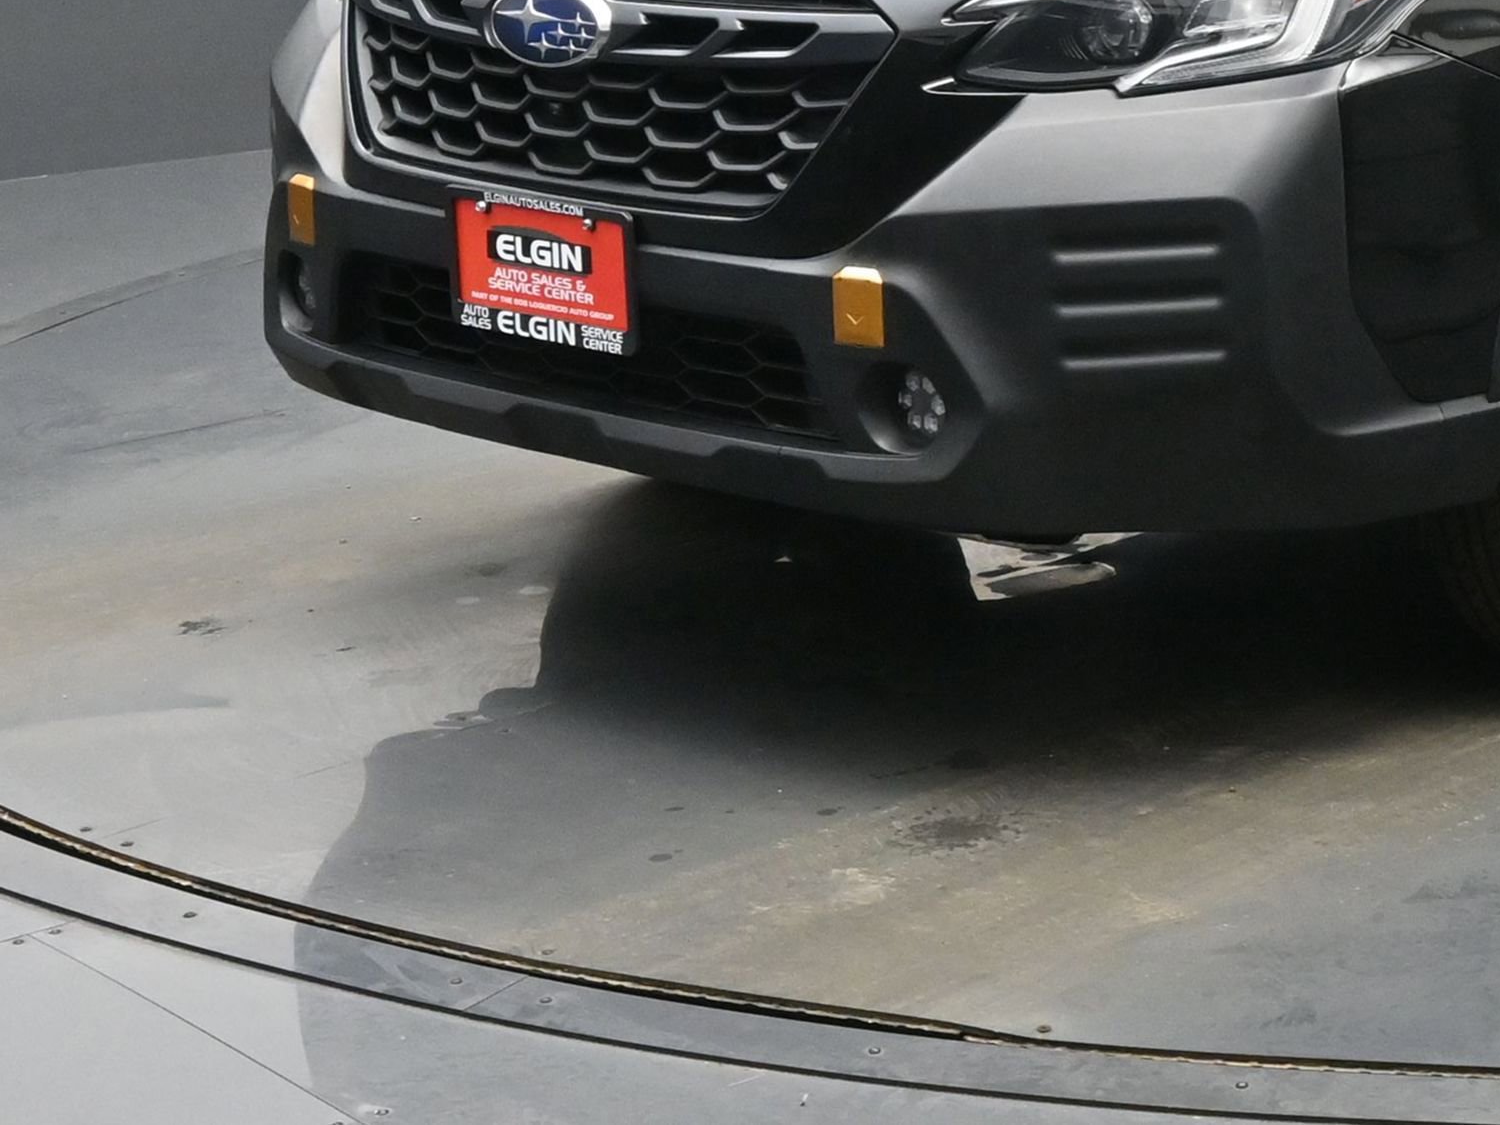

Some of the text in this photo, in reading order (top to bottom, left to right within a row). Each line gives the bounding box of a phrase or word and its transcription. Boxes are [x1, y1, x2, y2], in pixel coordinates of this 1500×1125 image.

[484, 192, 584, 217] ELGINAUTOSALES.COM
[496, 234, 583, 272] ELGIN
[488, 277, 594, 305] SERVICE CENTER
[494, 267, 586, 292] AUTO SALES &
[461, 315, 491, 330] SALES
[463, 304, 489, 318] AUTO
[497, 311, 576, 346] ELGIN
[581, 325, 623, 344] SERVICE
[583, 339, 622, 355] CENTER
